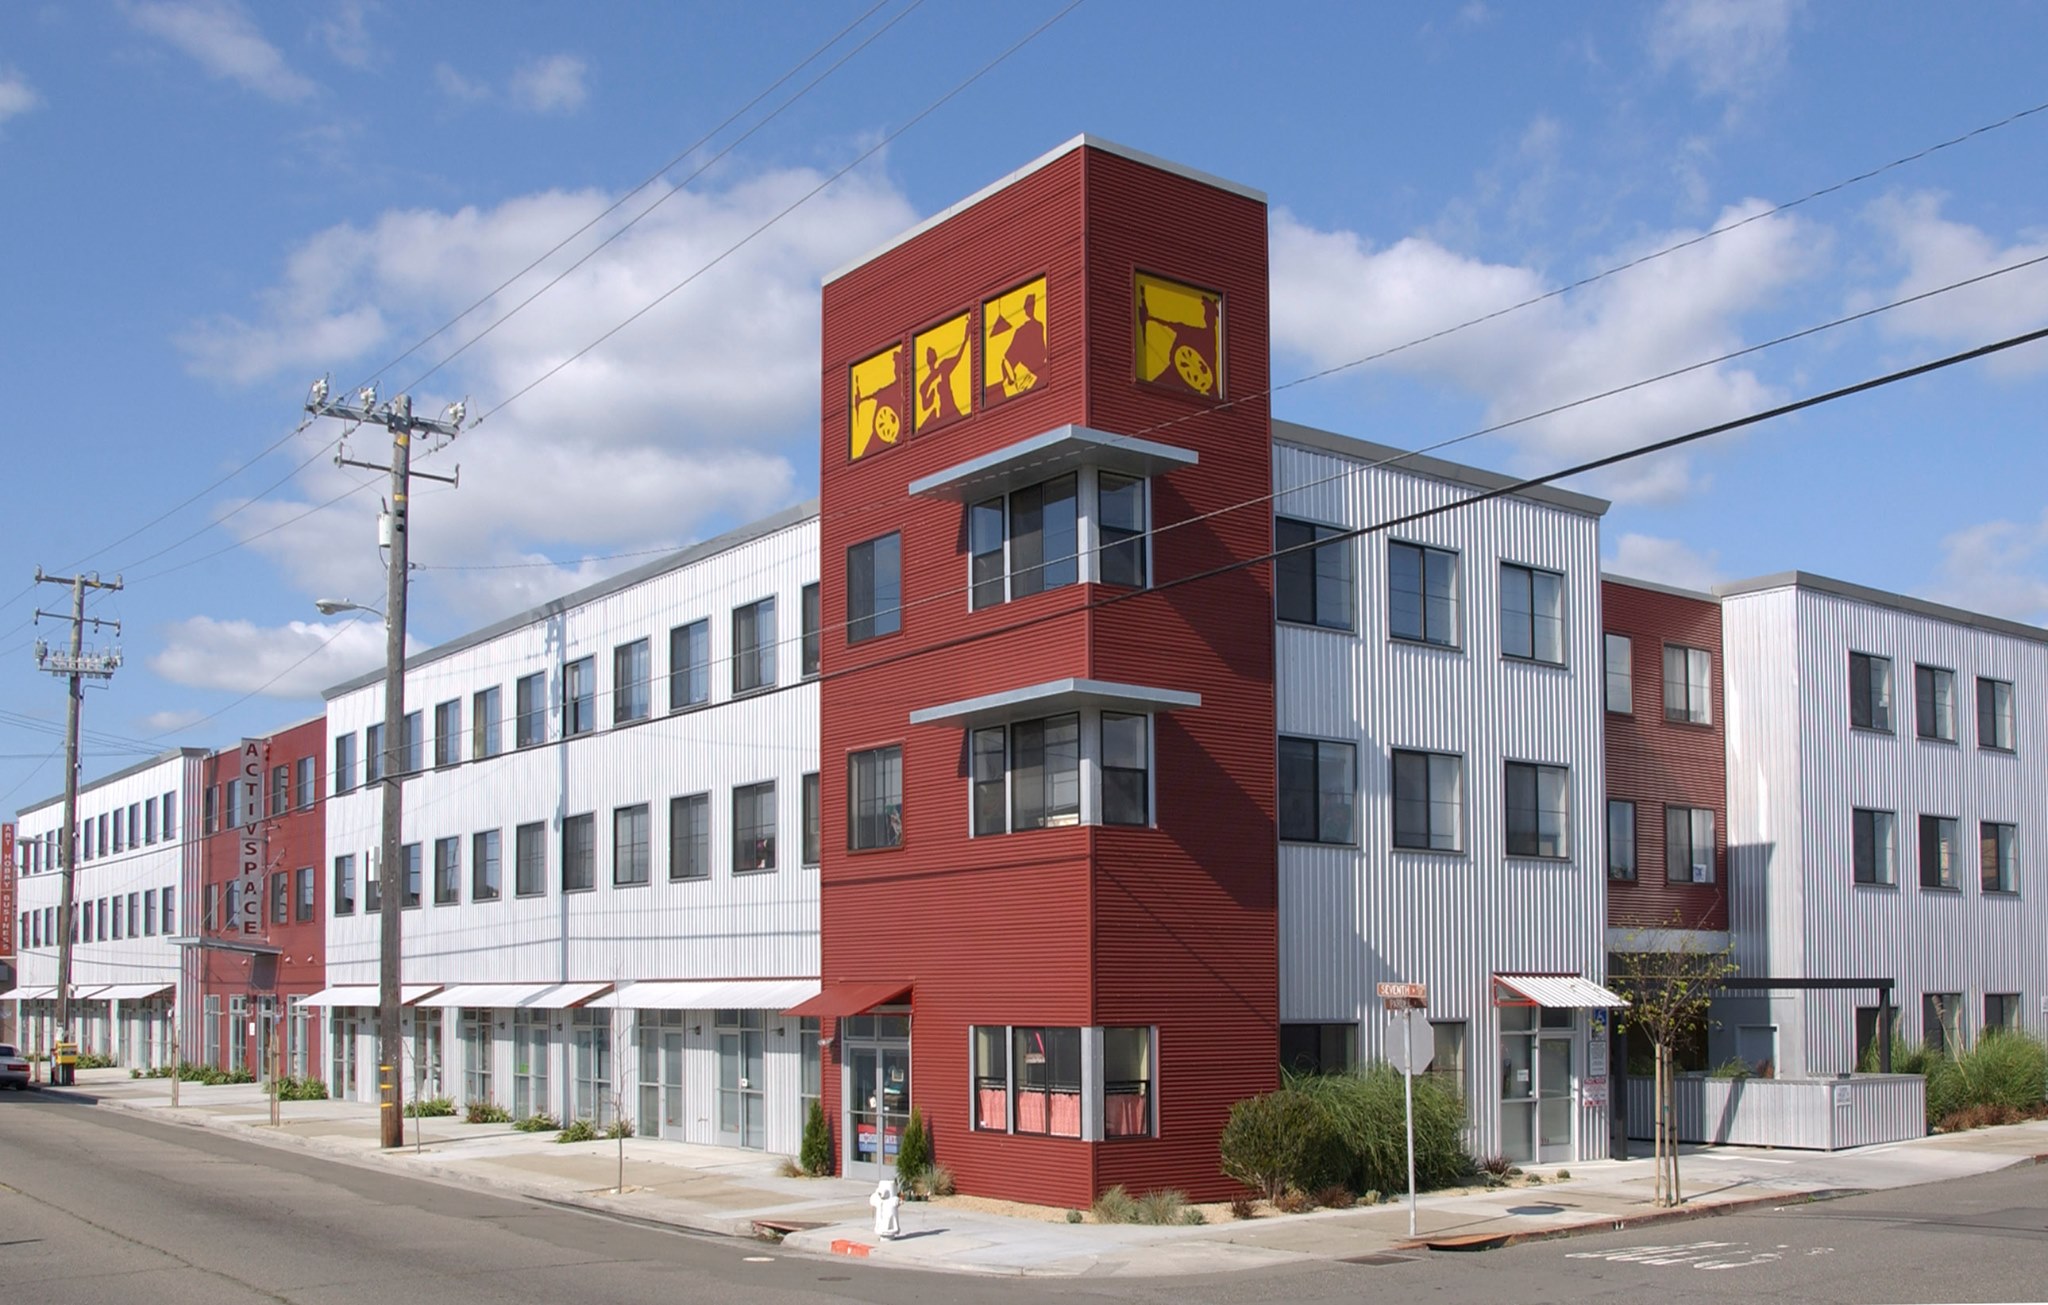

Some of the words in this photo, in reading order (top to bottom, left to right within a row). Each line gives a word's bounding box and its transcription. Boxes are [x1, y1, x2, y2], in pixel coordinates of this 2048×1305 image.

[244, 743, 258, 934] ACTIVSPACE
[4, 854, 12, 888] HOBBY
[2, 894, 10, 950] BUSINESS
[1380, 985, 1409, 995] SEVENTH
